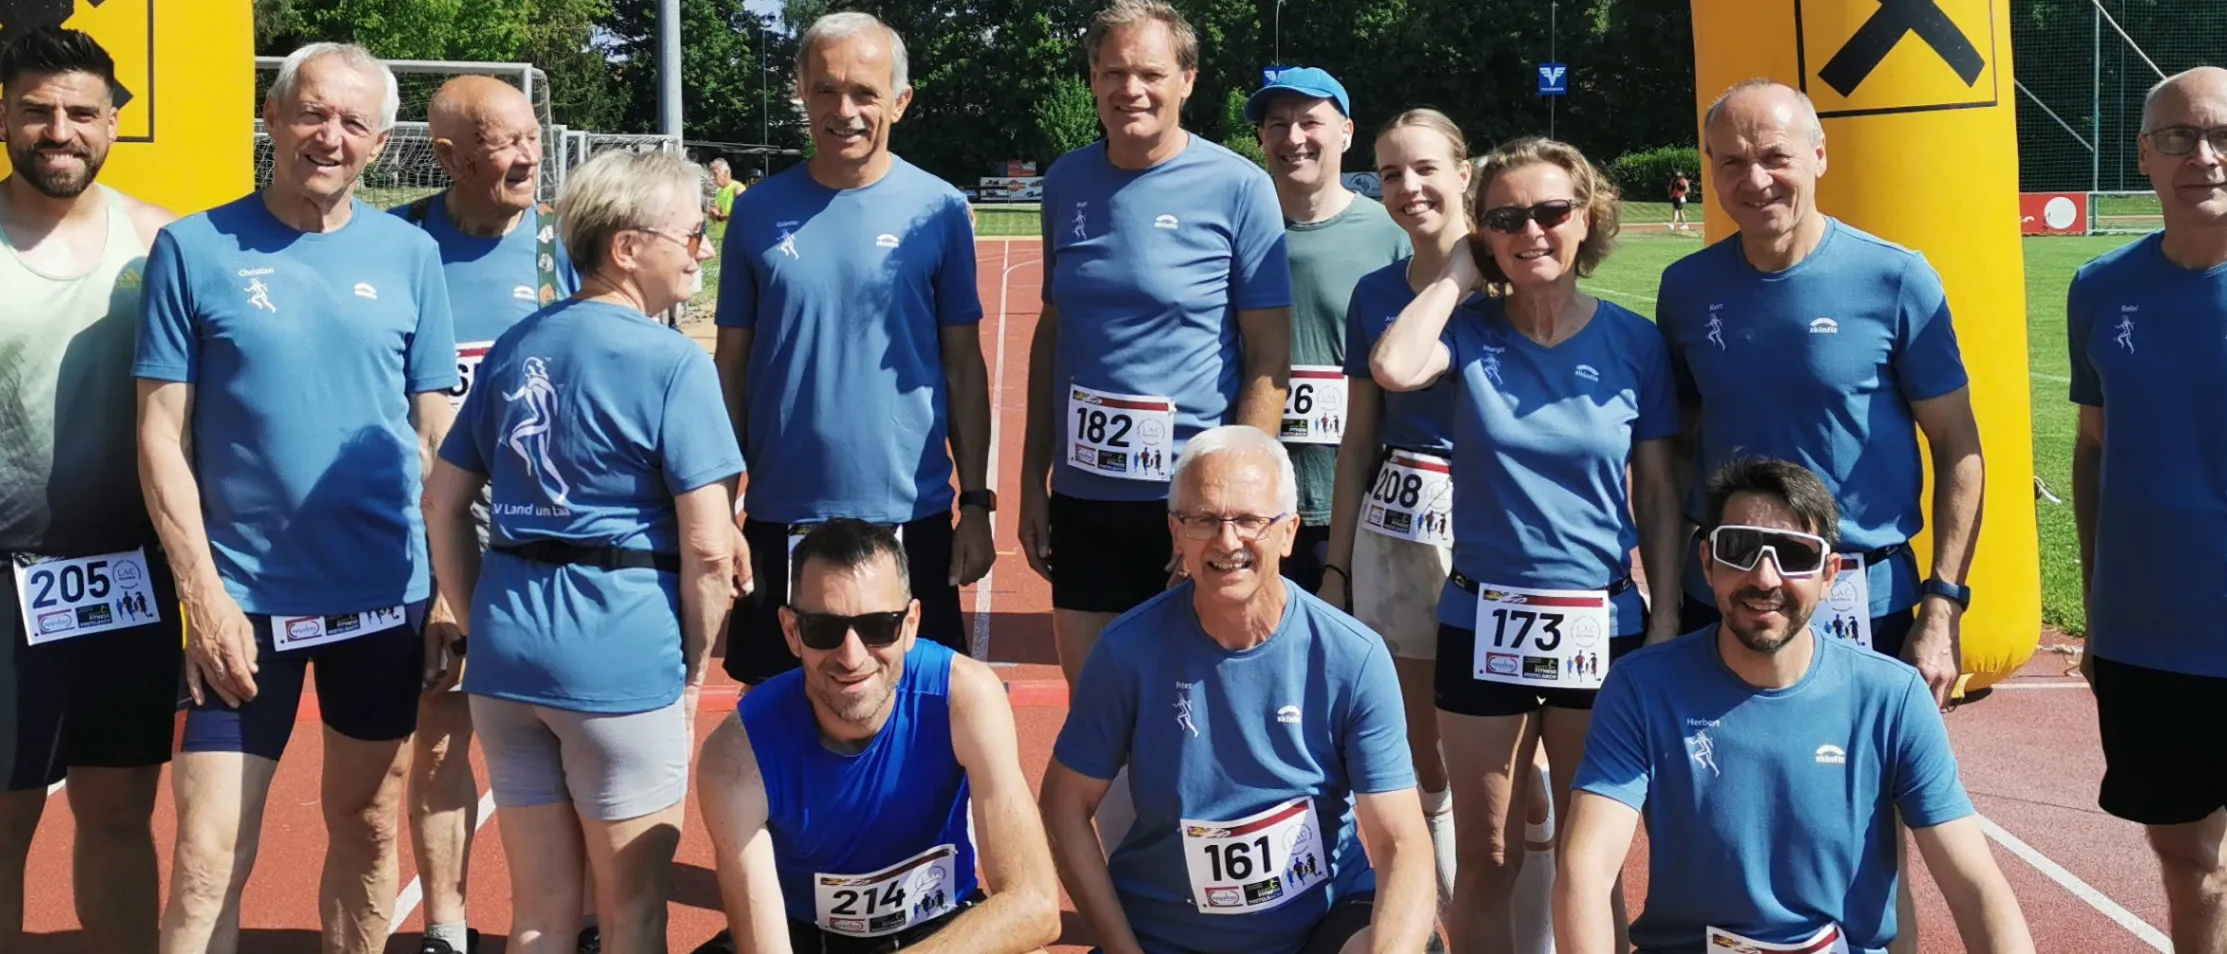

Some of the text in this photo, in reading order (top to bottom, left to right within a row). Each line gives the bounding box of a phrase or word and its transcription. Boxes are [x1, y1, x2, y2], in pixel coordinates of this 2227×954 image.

[238, 267, 275, 277] Christian
[1077, 407, 1133, 448] 182
[1373, 467, 1422, 508] 208
[504, 503, 534, 515] Land
[30, 560, 111, 609] 205
[1492, 608, 1564, 651] 173
[1687, 718, 1720, 727] Herbert
[1204, 835, 1272, 882] 161
[830, 879, 906, 915] 214
